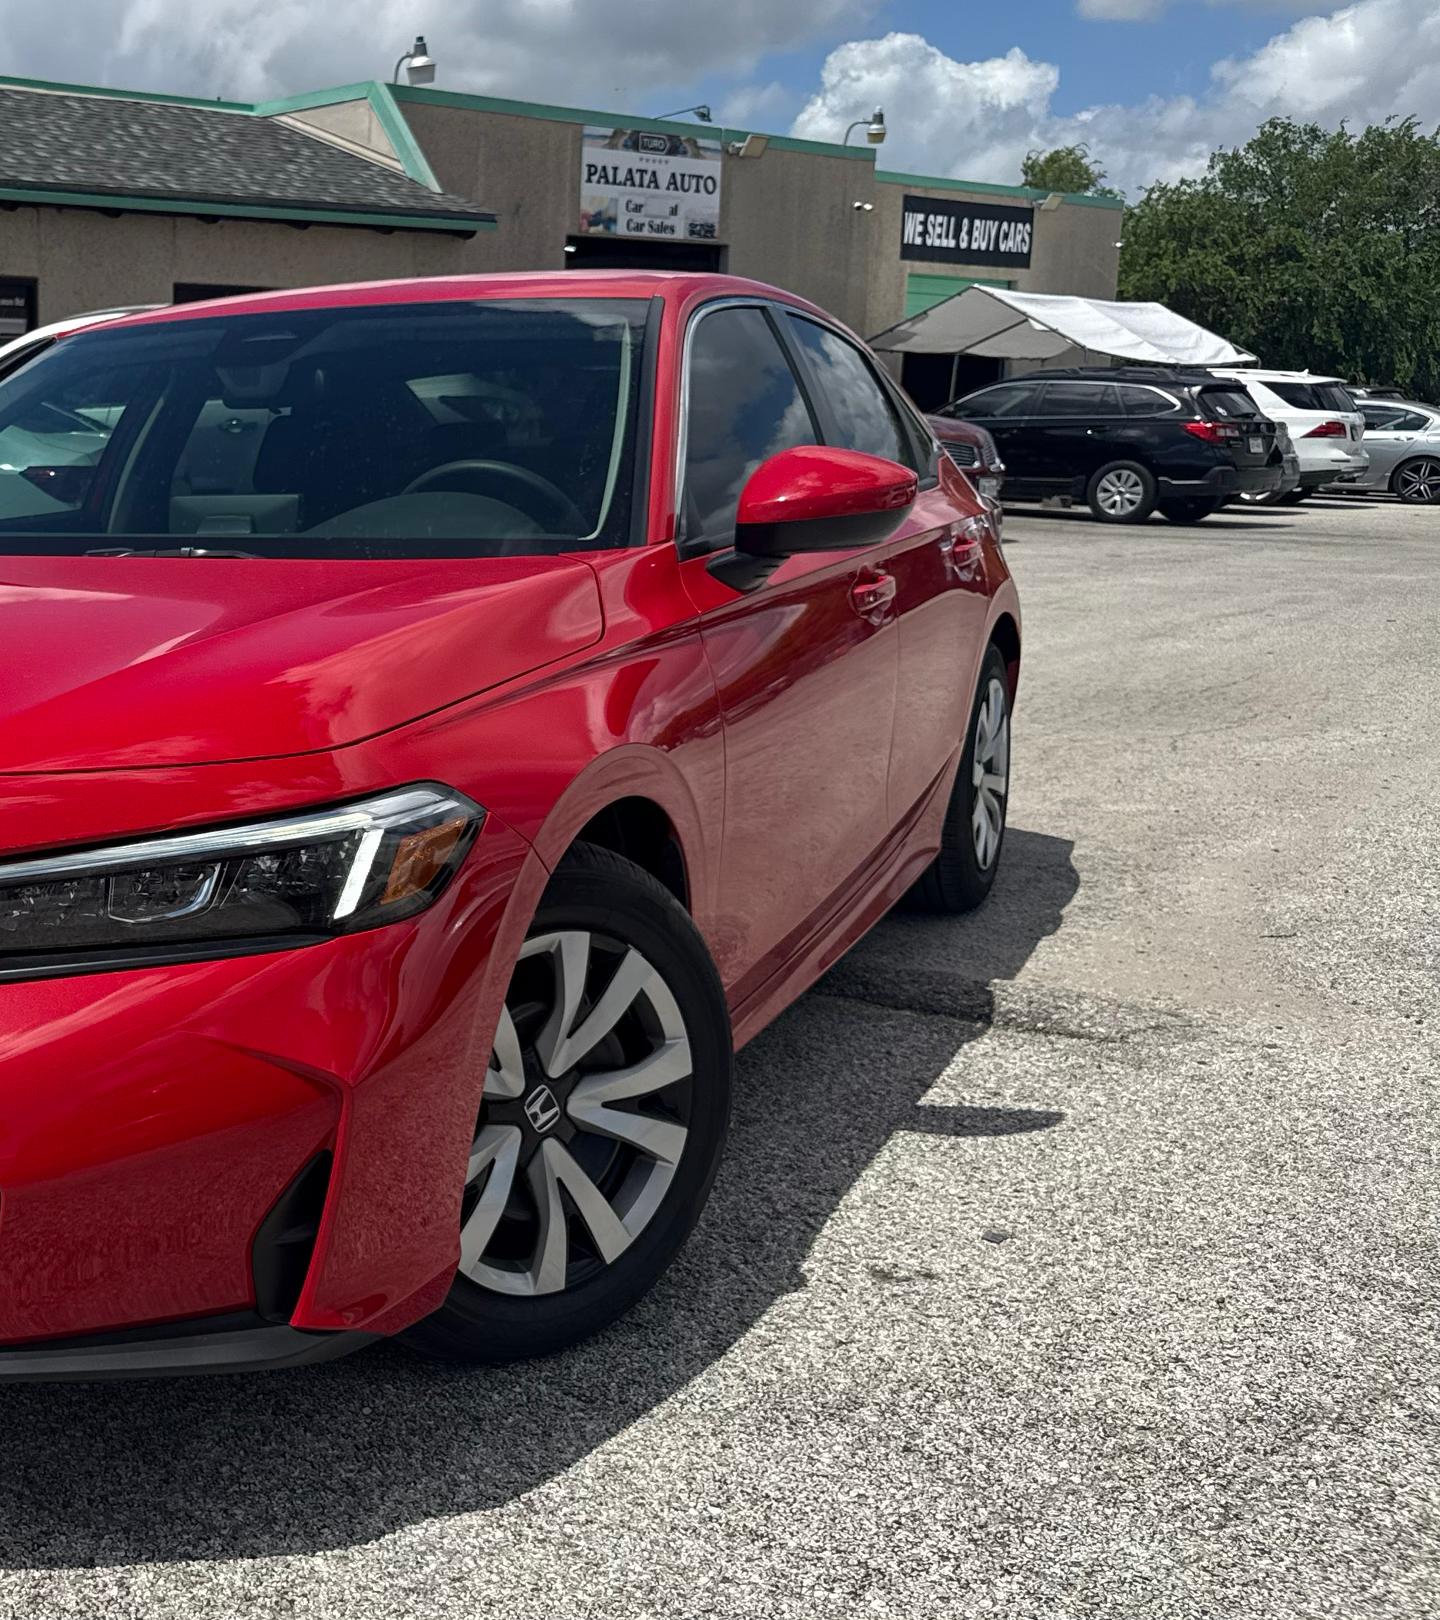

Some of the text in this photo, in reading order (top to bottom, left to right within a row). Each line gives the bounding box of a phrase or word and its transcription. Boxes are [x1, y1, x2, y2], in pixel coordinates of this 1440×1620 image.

[585, 164, 717, 195] PALATA AUTO
[625, 199, 644, 214] Car
[626, 218, 676, 235] Car Sales
[903, 211, 1032, 254] WE SELL & BUY CARS
